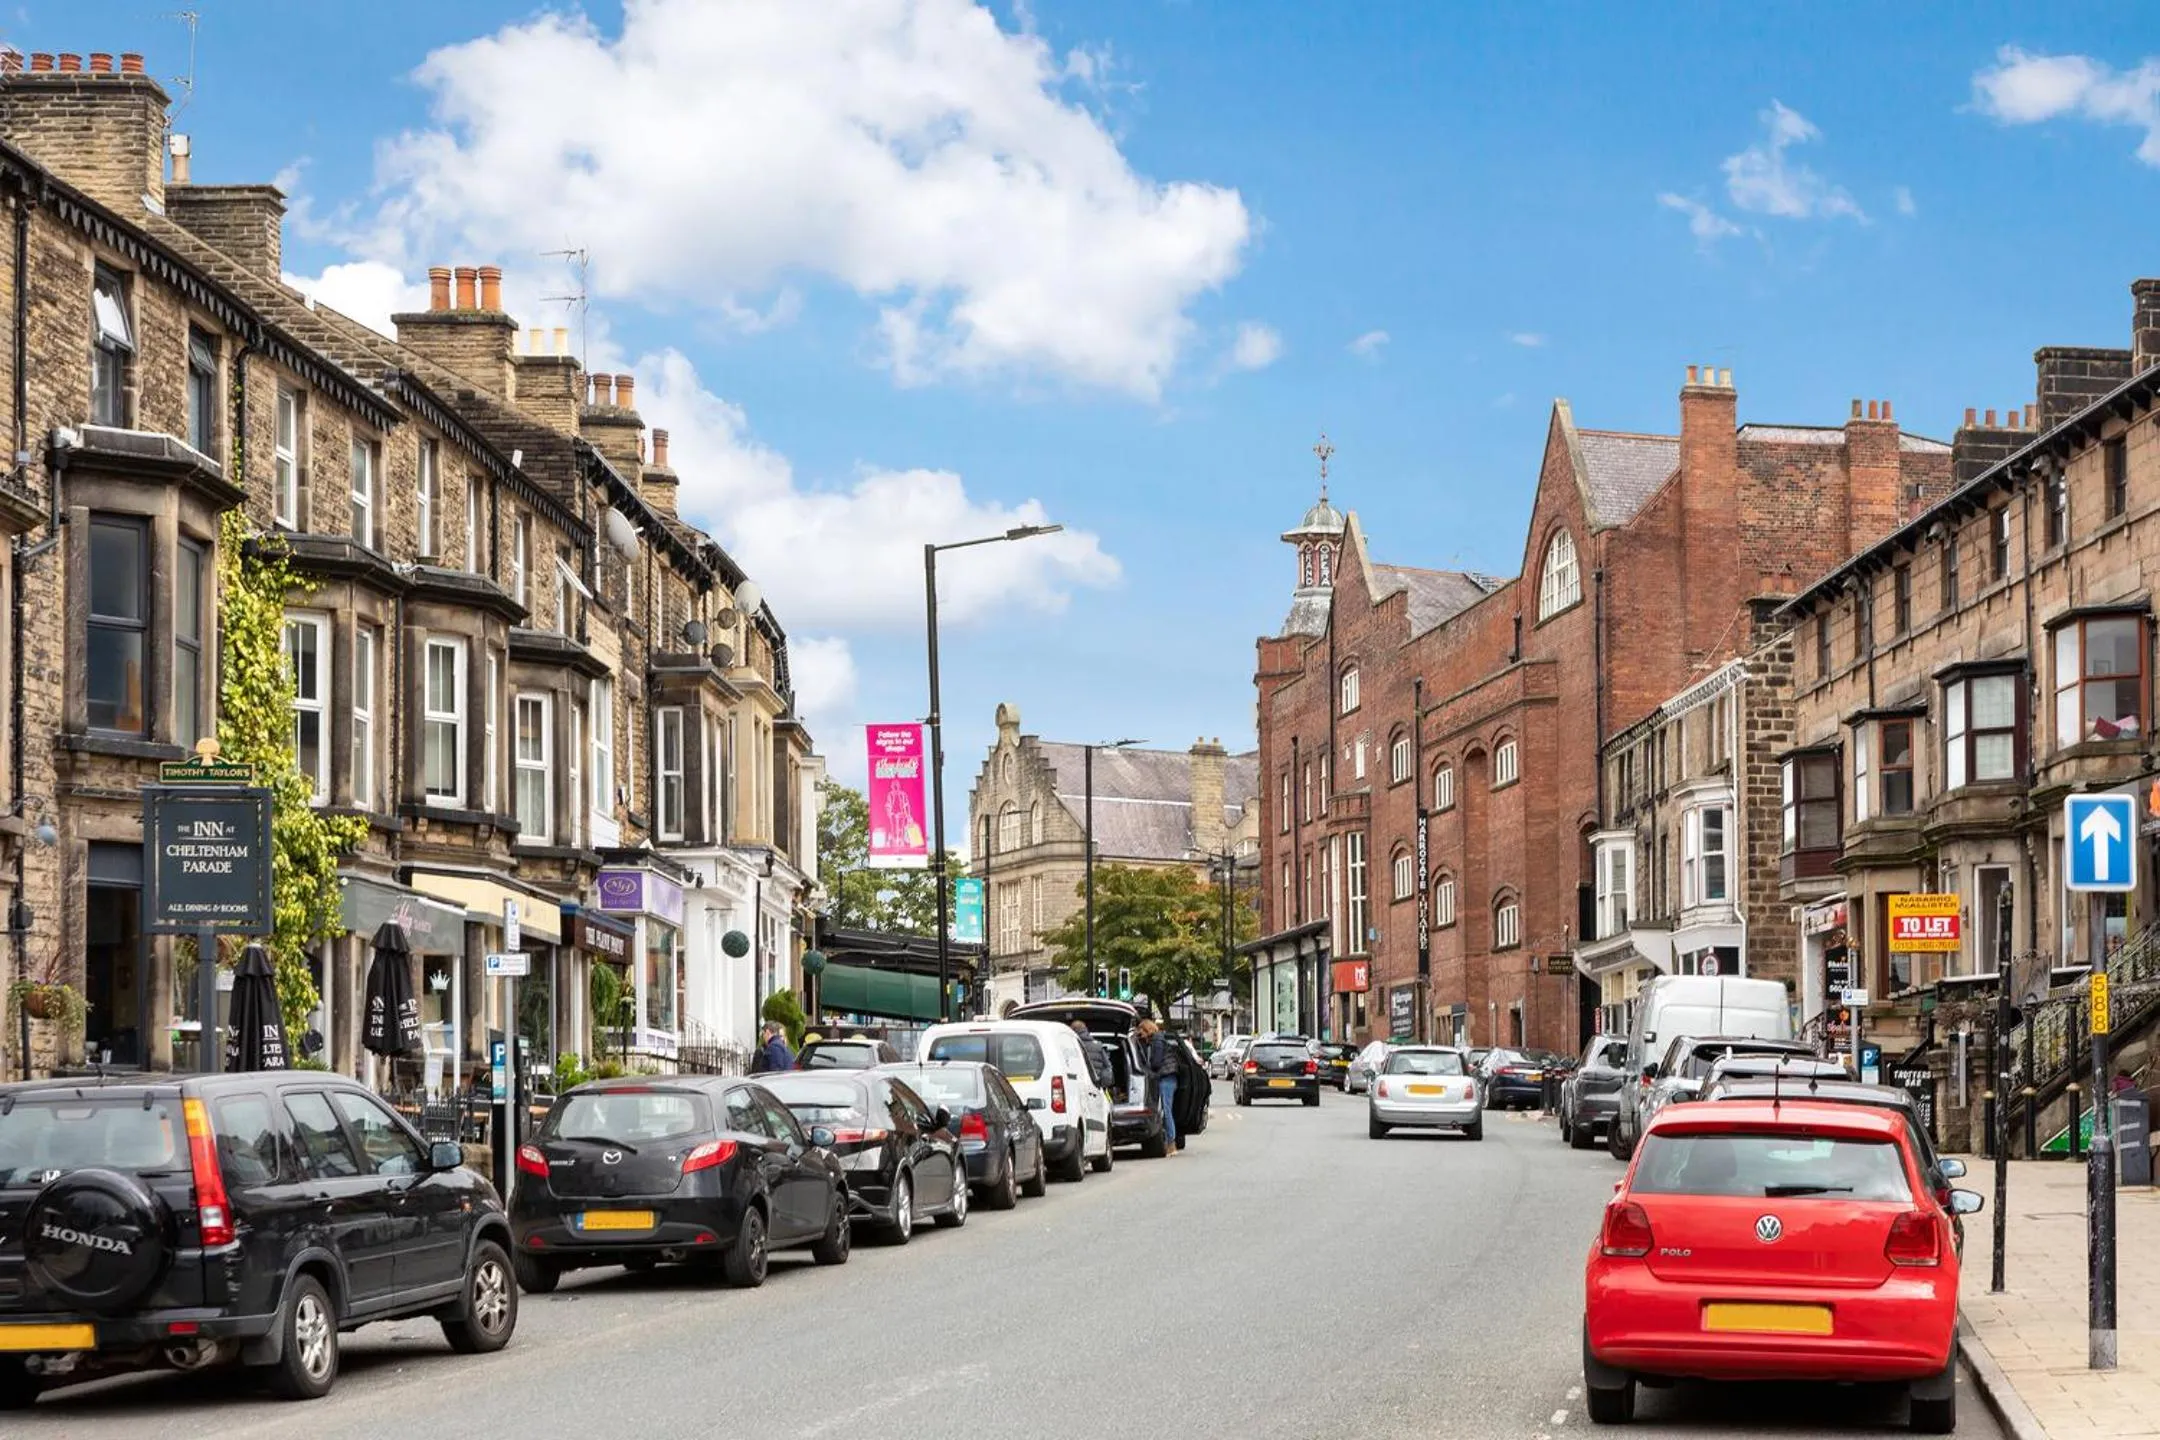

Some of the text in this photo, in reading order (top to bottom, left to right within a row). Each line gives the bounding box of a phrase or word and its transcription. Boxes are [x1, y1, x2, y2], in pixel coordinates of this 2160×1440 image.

[165, 769, 250, 777] TIMOTHY TAYLOR'S
[178, 825, 190, 833] THE
[194, 821, 224, 836] INN
[166, 844, 248, 857] CHELTENHAM
[1419, 818, 1427, 889] HARROGATE
[183, 861, 232, 873] PARADE
[185, 903, 212, 912] DINING
[221, 904, 249, 912] ROOMS
[1901, 917, 1952, 932] TO LET
[496, 1043, 505, 1062] P
[1864, 1050, 1873, 1064] P
[1894, 1070, 1931, 1079] TROTTERS
[1905, 1079, 1921, 1087] BAR
[41, 1223, 133, 1255] HONDA
[1660, 1247, 1692, 1257] POLO
